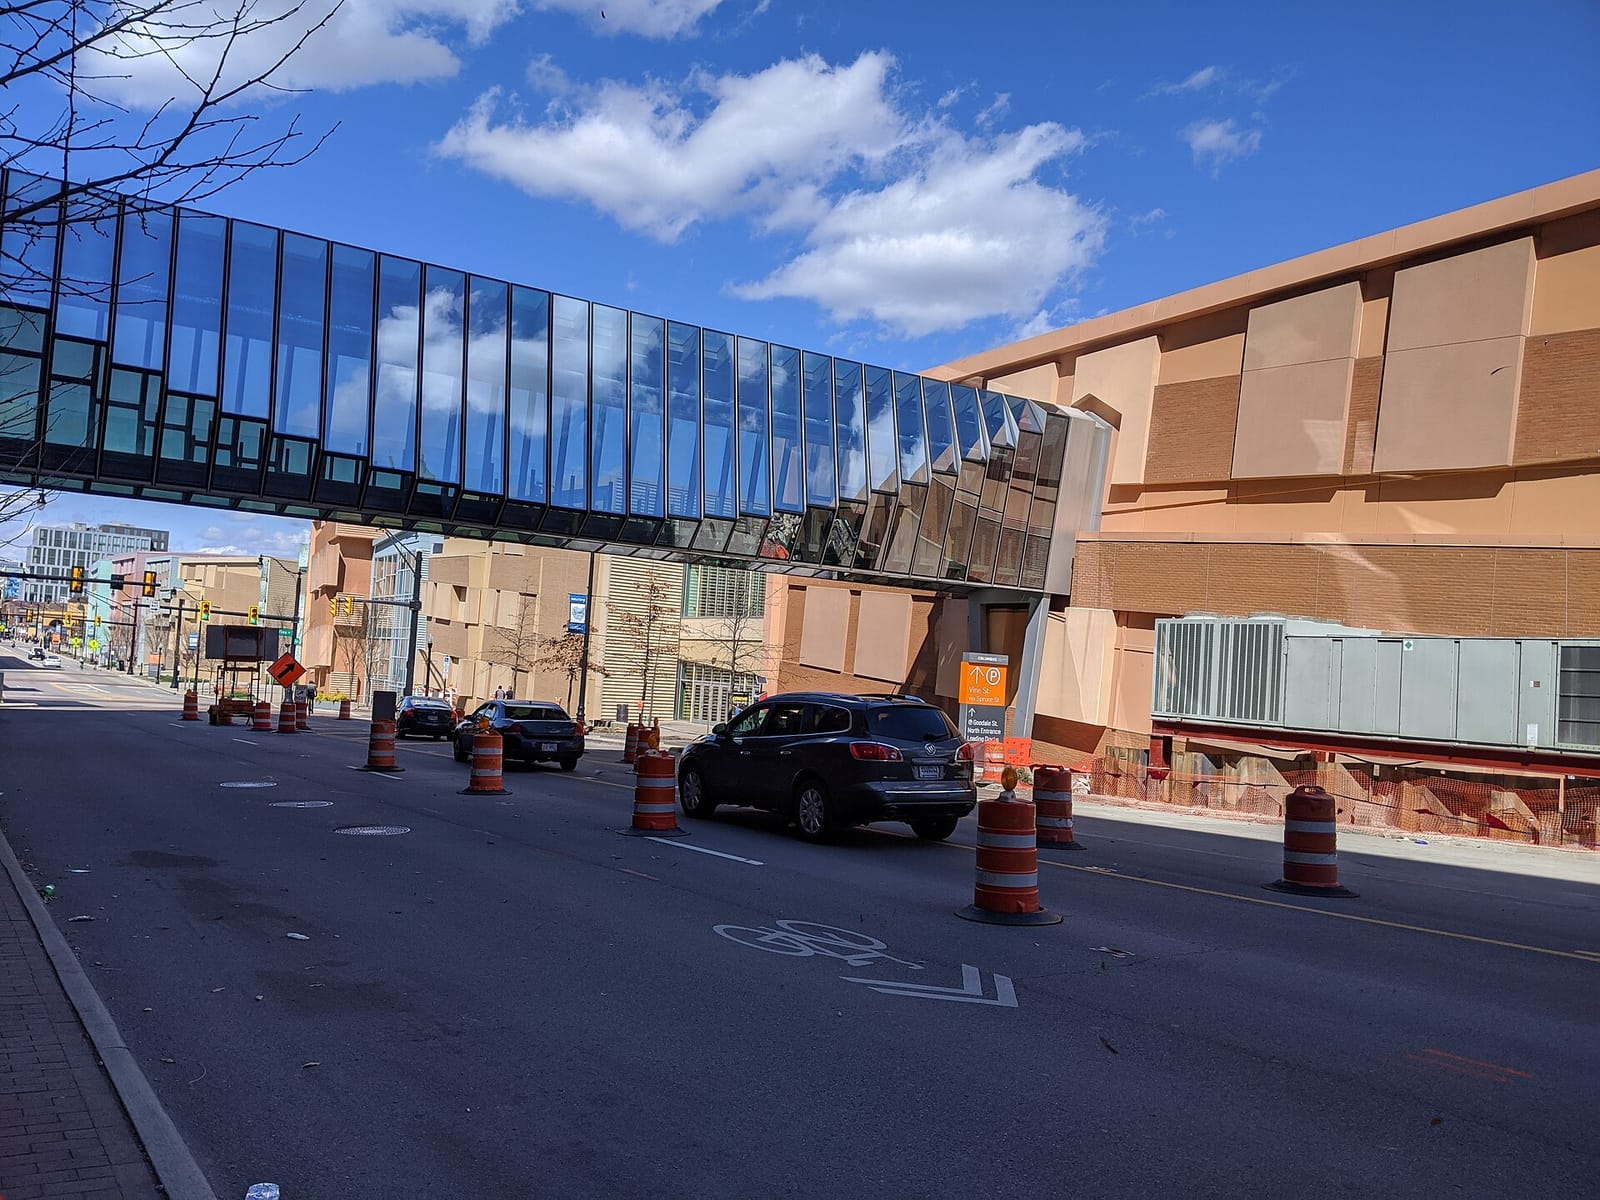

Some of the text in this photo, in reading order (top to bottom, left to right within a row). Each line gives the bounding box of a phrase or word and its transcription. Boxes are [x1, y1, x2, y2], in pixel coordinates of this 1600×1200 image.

[968, 686, 981, 694] Vine
[973, 719, 992, 727] Goodale
[980, 727, 1002, 735] Entrance
